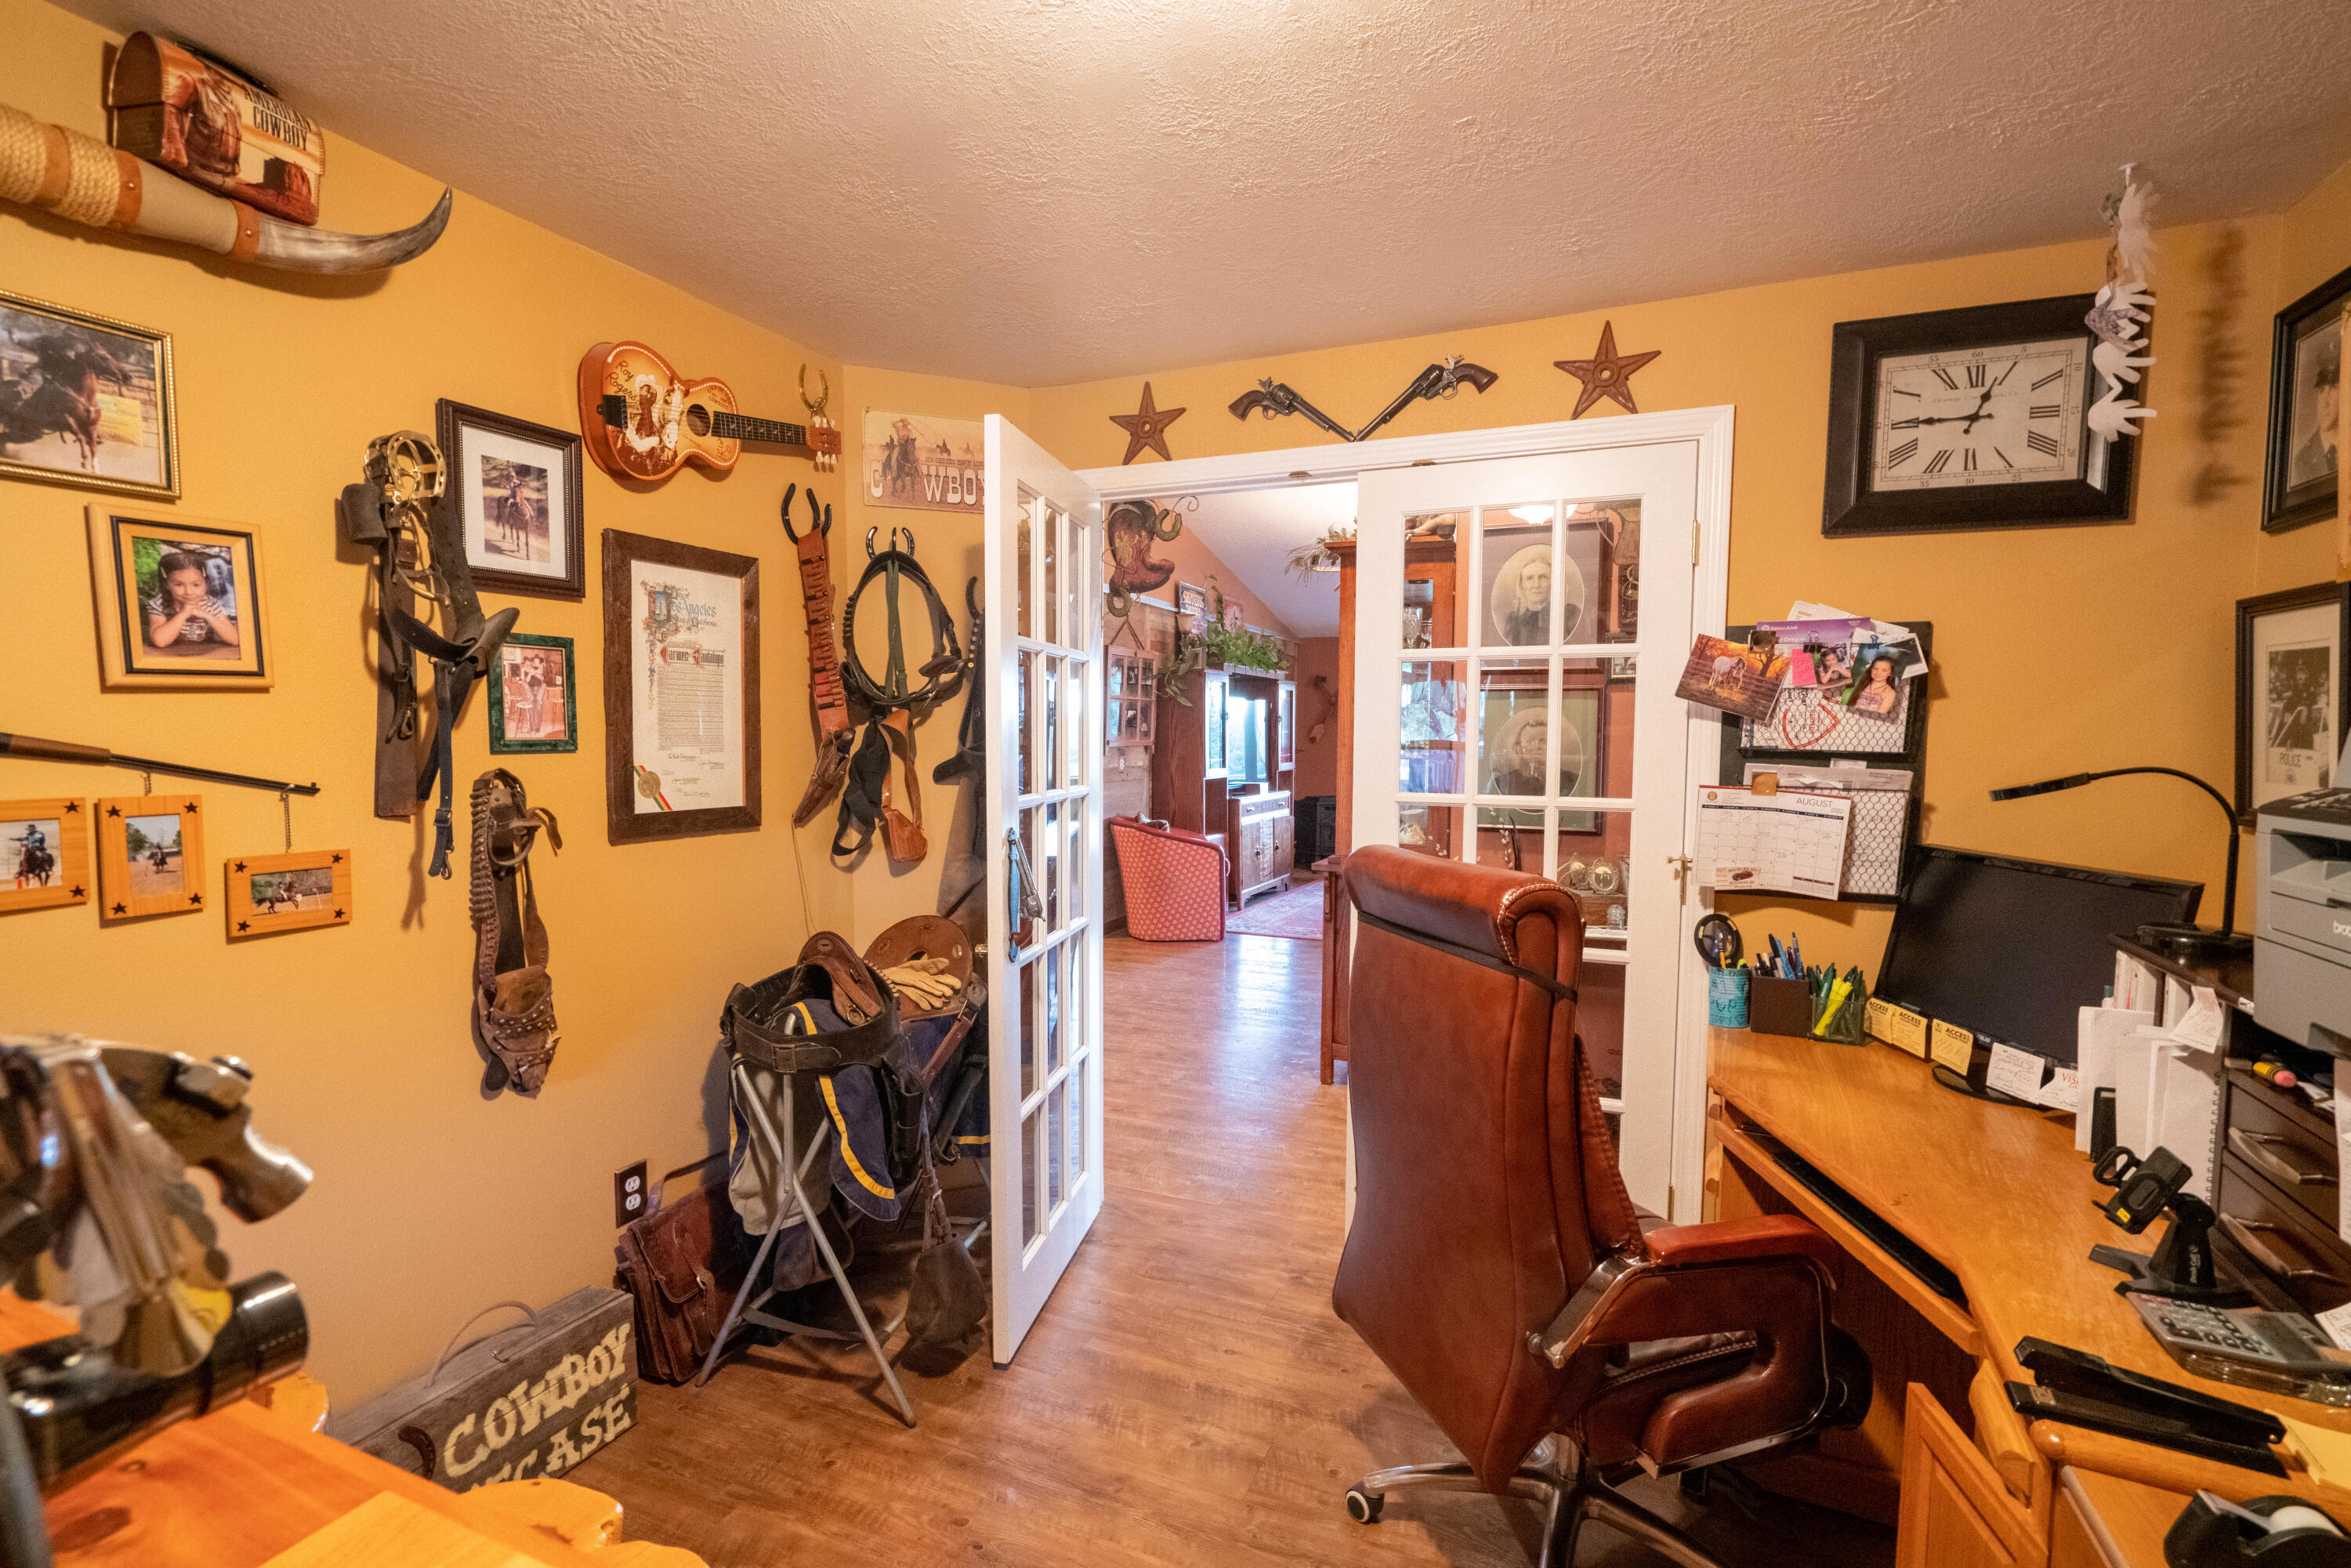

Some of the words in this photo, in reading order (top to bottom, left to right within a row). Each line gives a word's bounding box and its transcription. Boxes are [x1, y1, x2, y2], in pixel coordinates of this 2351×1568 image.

[253, 105, 307, 151] COWBOY
[1928, 355, 1940, 364] 55
[615, 360, 635, 382] Roy
[605, 371, 639, 401] Rogers
[1920, 480, 1930, 488] 35
[1963, 477, 1975, 487] 30
[2011, 473, 2023, 483] 25
[1795, 797, 1834, 808] AUGUST
[1868, 1001, 1889, 1013] ACCESS
[1899, 1012, 1922, 1026] ACCESS
[1945, 1027, 1969, 1041] ACCESS
[444, 1322, 631, 1479] COWBOY
